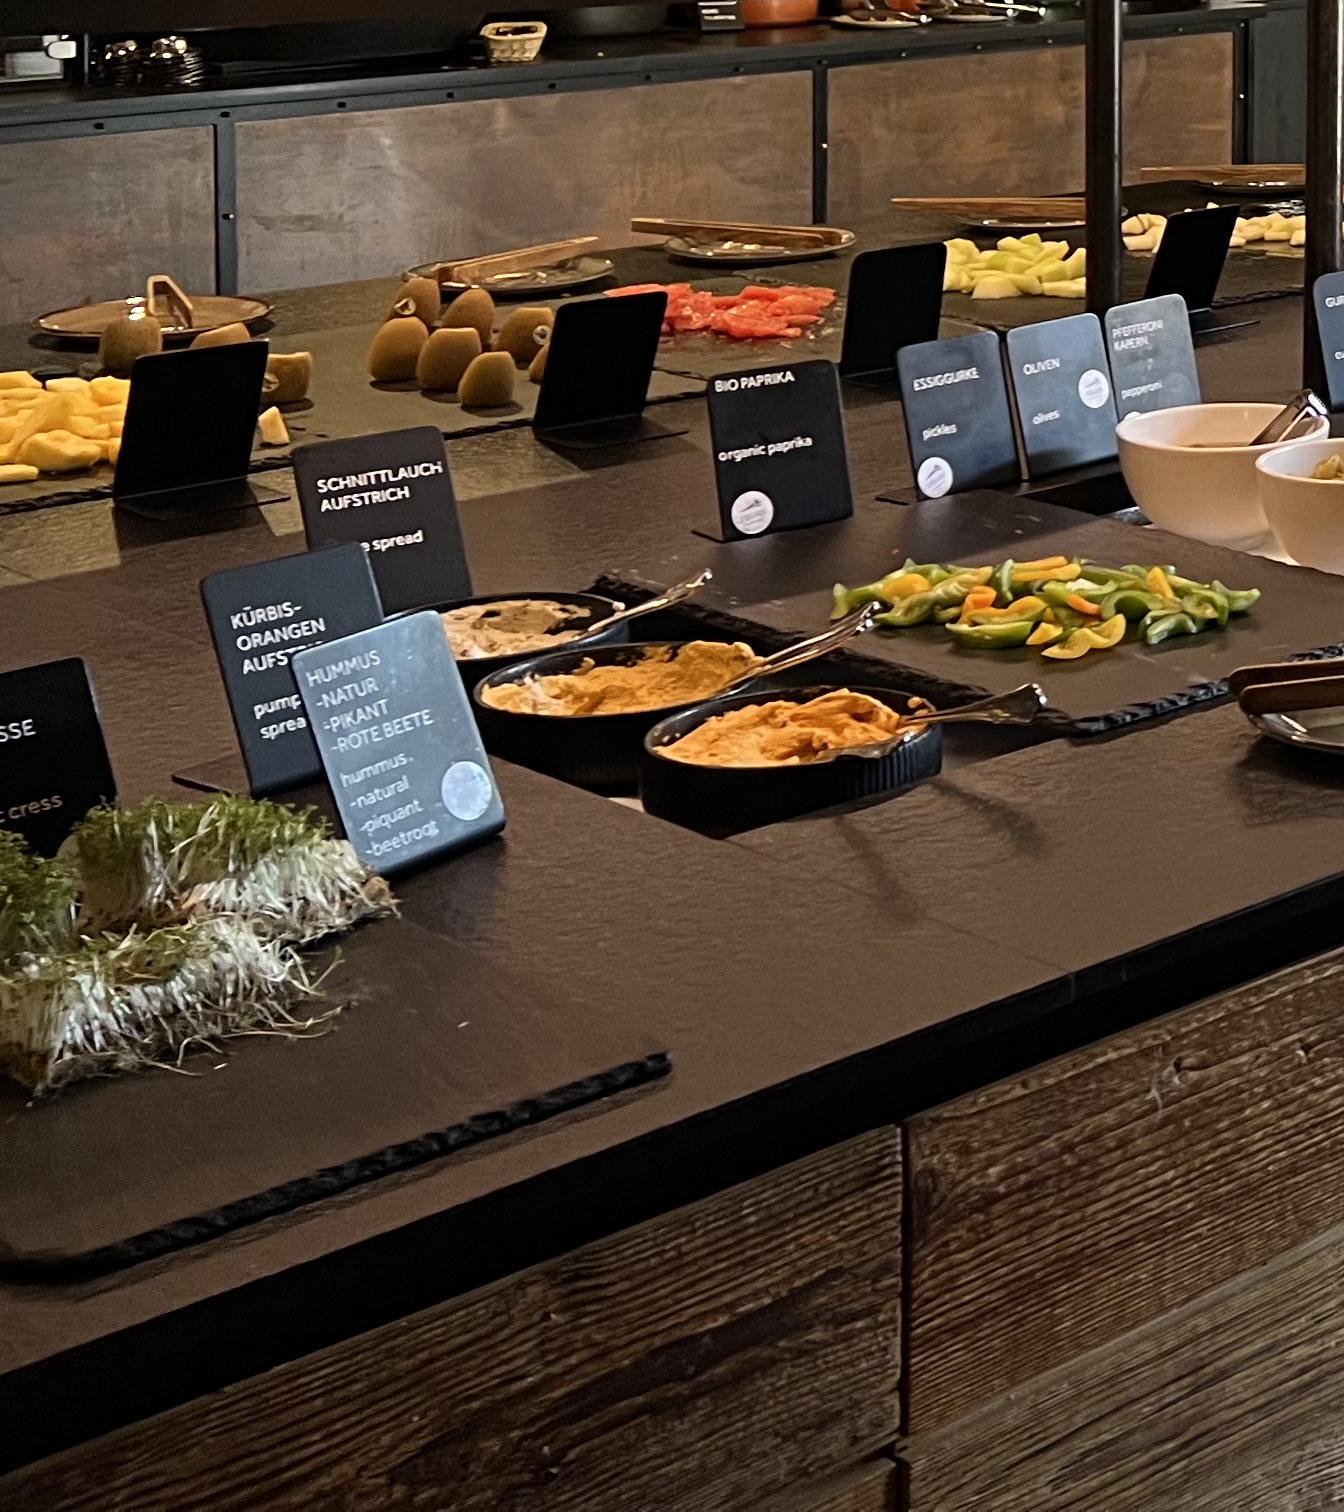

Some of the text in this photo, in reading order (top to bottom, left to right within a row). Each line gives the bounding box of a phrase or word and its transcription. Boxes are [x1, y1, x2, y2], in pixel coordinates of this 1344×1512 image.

[913, 367, 980, 391] ESSIGGURKE
[1022, 357, 1061, 375] OLIVEN
[714, 370, 796, 392] BIO PAPRIKA
[1032, 410, 1060, 425] olives
[922, 424, 957, 441] pickles
[718, 437, 813, 463] organic paprika
[316, 461, 443, 493] SCHNITTLAUCH
[320, 485, 411, 512] AUFSTRICH
[372, 529, 424, 553] spread
[230, 601, 302, 630] KÜRBIS-
[236, 617, 326, 651] ORANGEN
[306, 649, 381, 688] HUMMUS
[316, 677, 380, 709] -NATUR
[323, 698, 389, 733] -PIKANT
[330, 708, 435, 753] -ROTE BEETE
[348, 775, 410, 808] -natural
[8, 795, 63, 819] cress
[358, 799, 424, 837] -piquant
[365, 820, 440, 857] -beetroot
